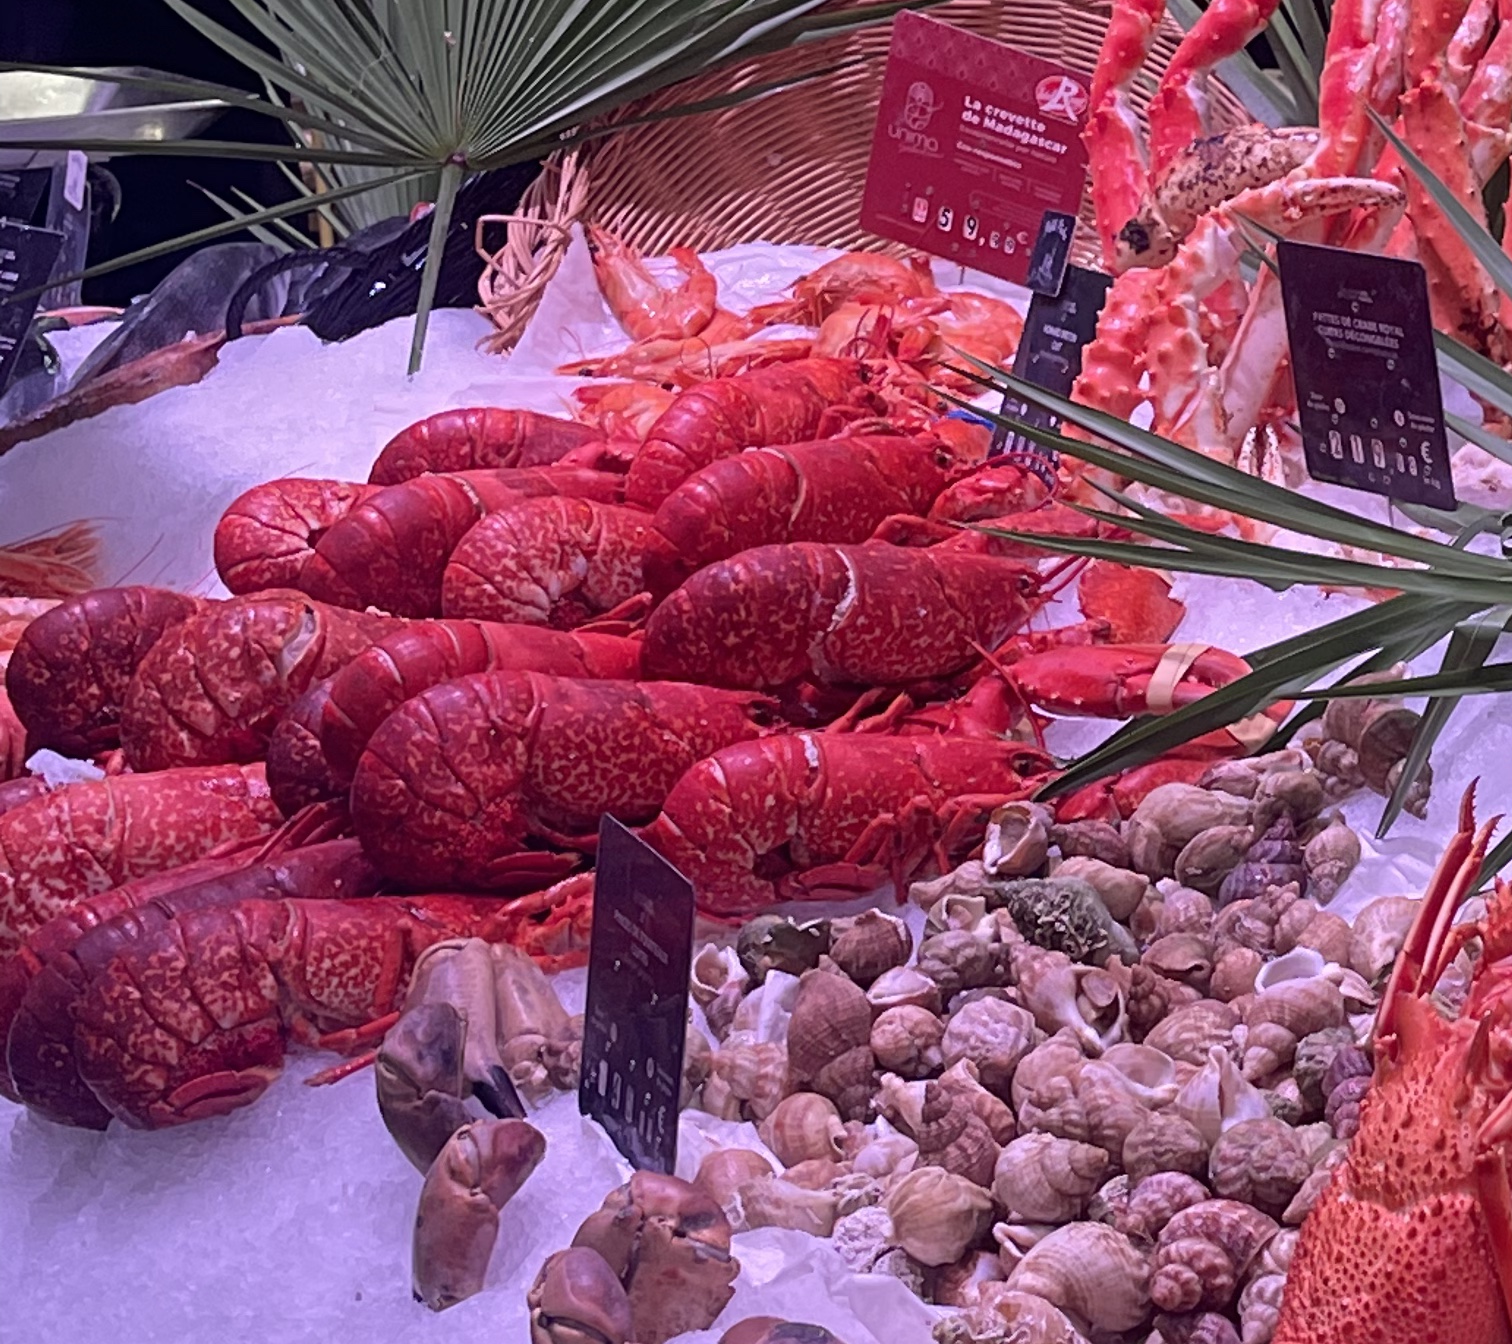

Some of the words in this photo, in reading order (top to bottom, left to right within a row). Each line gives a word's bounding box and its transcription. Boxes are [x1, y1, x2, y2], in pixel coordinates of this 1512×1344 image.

[961, 110, 980, 126] de
[982, 116, 1068, 155] Madagascar
[964, 95, 982, 111] La
[985, 104, 1046, 133] crevette
